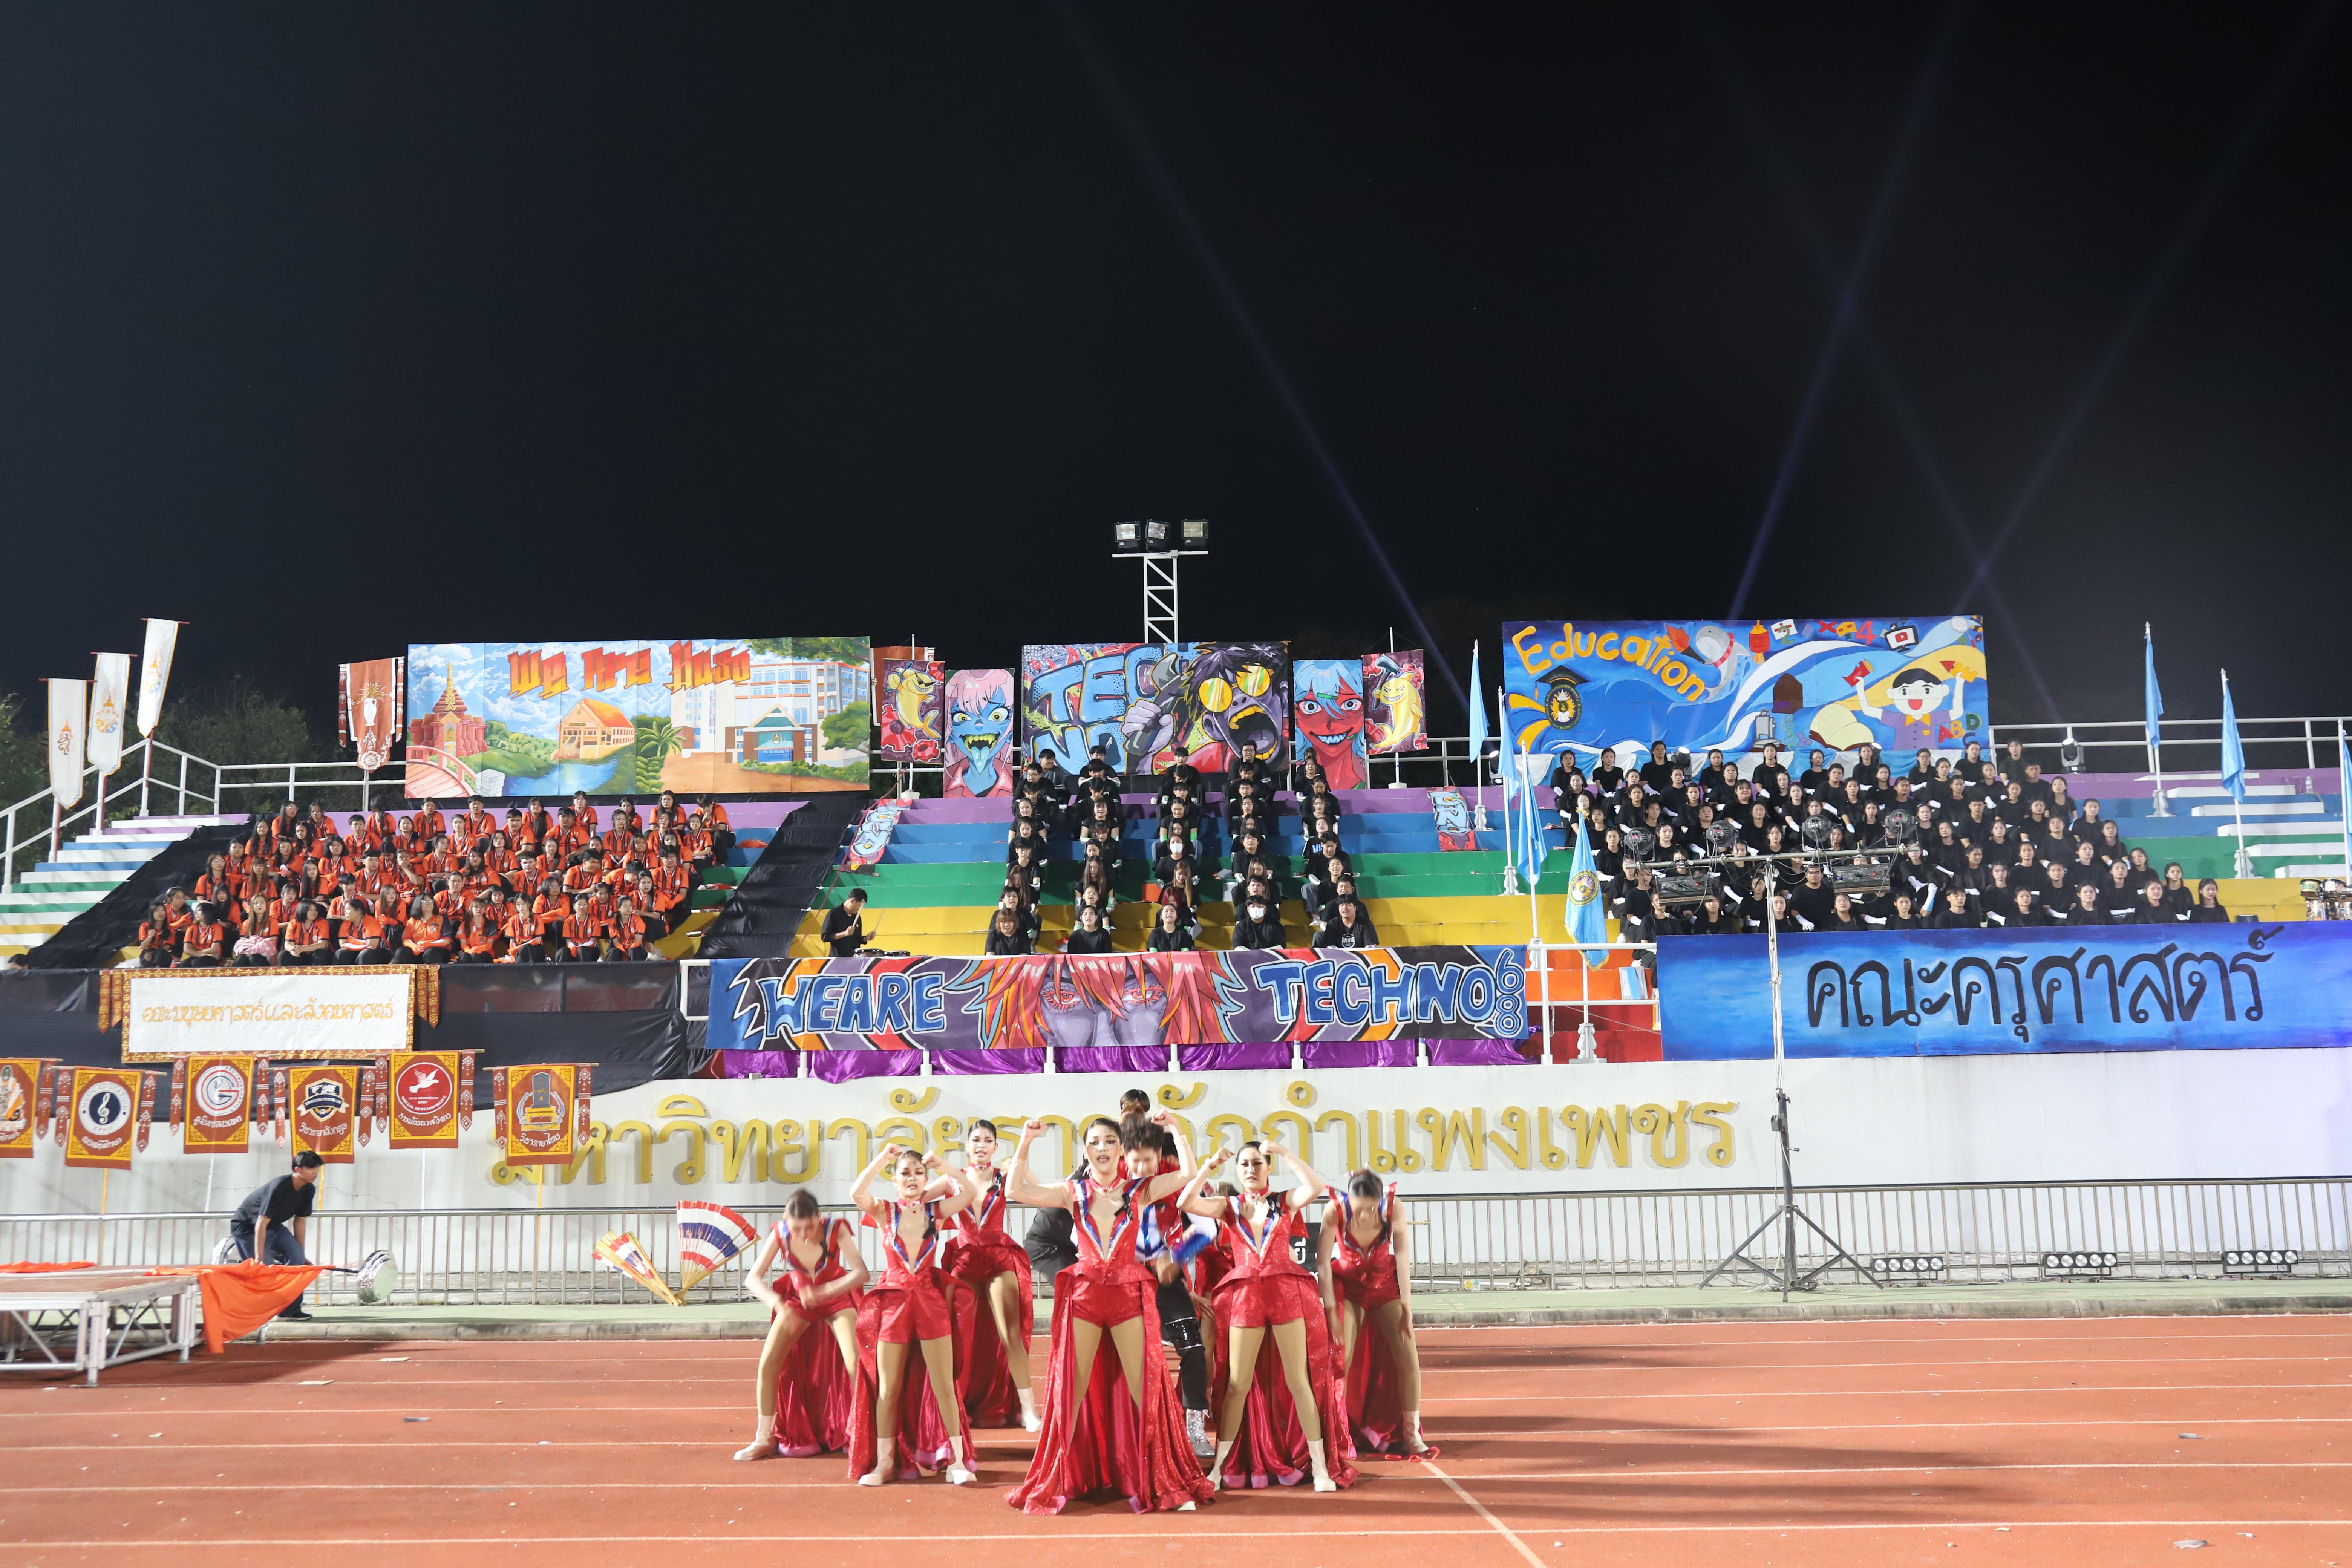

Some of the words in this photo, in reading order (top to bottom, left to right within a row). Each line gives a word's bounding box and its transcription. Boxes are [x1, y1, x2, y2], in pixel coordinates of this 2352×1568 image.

[507, 649, 569, 700] We
[581, 646, 652, 692] Are
[1511, 623, 1705, 701] Education
[1252, 960, 1496, 1027] TECHNO
[1809, 926, 2284, 1043] คณะครุศาสตร์
[98, 1084, 128, 1110] EDUCATION
[401, 1095, 415, 1109] SOCIAL
[414, 1095, 446, 1111] DEVELOPMENT
[398, 1113, 452, 1126] การพัฒนาสังคม
[519, 1132, 561, 1147] วิชาภาษาไทย
